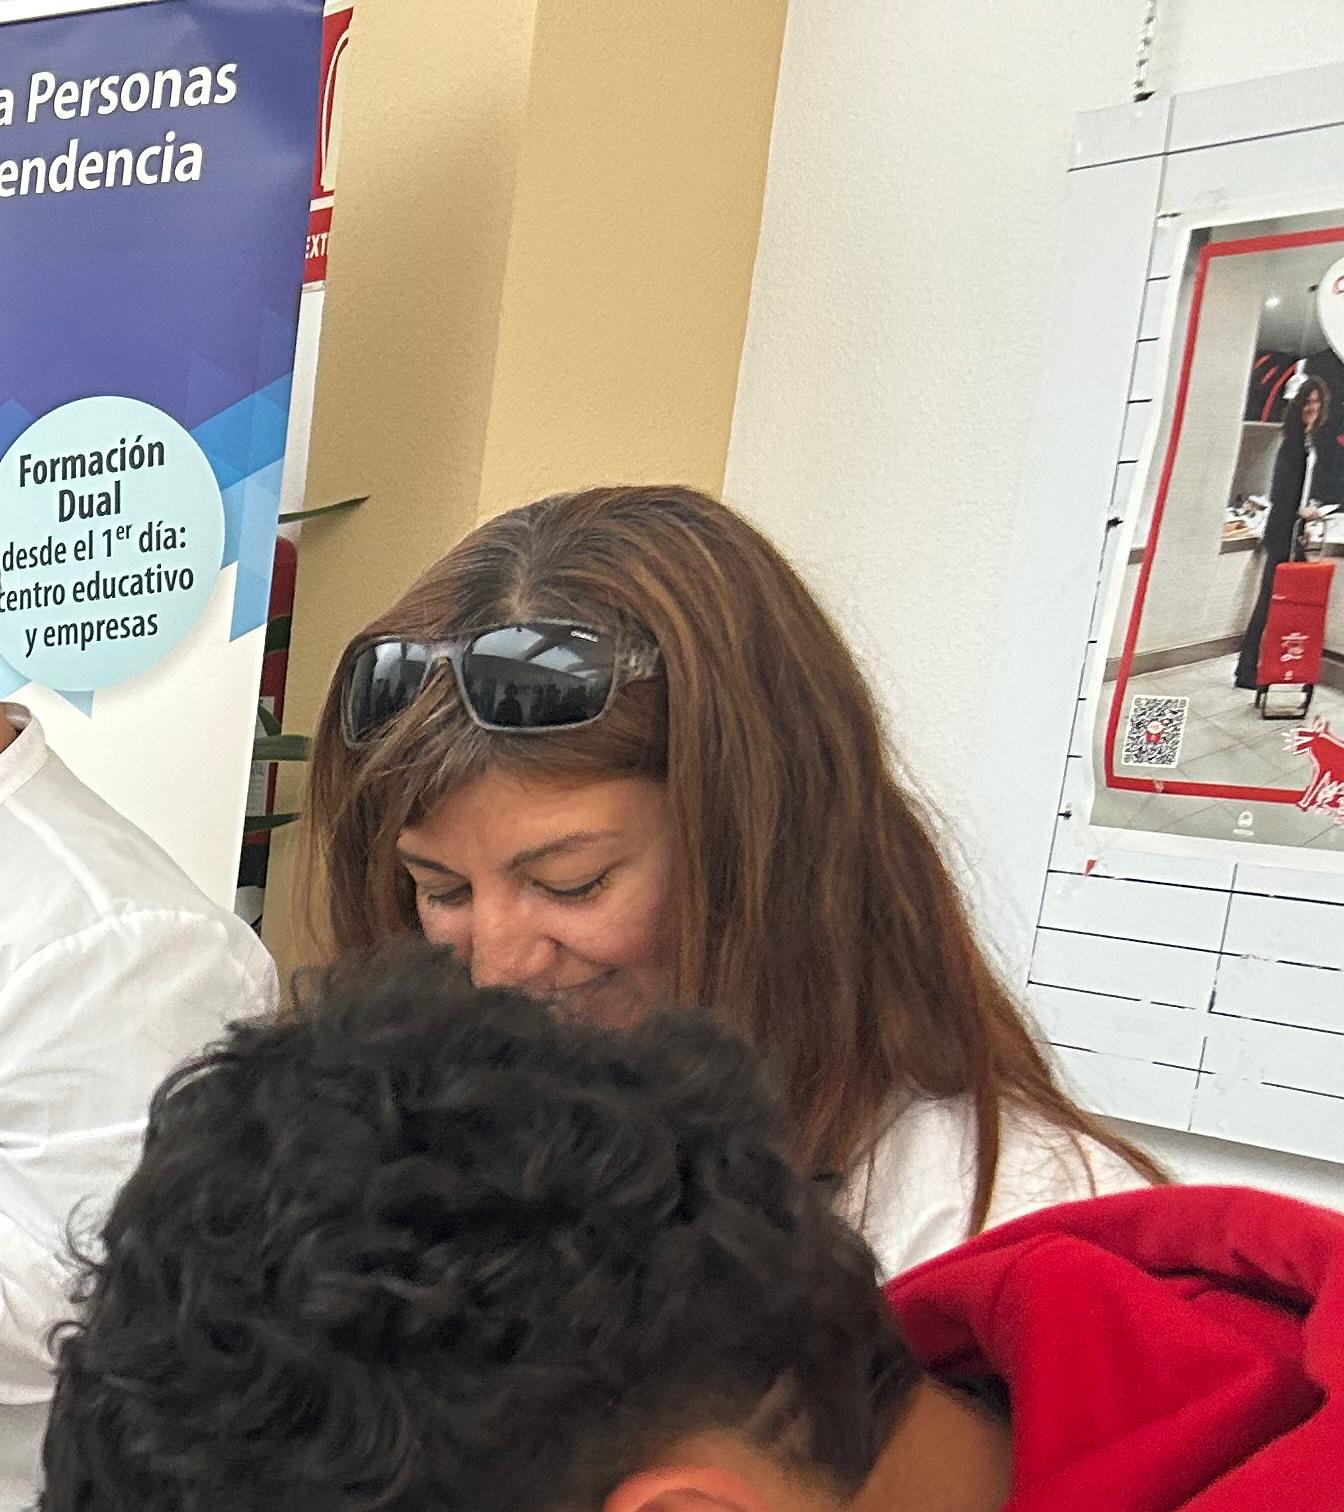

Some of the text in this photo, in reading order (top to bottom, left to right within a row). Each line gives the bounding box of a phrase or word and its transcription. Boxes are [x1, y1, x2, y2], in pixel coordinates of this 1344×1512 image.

[27, 64, 237, 122] Personas
[305, 232, 328, 259] EXT
[20, 435, 165, 487] Formación
[59, 480, 121, 522] Dual
[2, 536, 66, 572] desde
[74, 530, 94, 561] el
[139, 520, 186, 553] día:
[73, 564, 194, 602] educativo
[25, 613, 158, 658] y empresas
